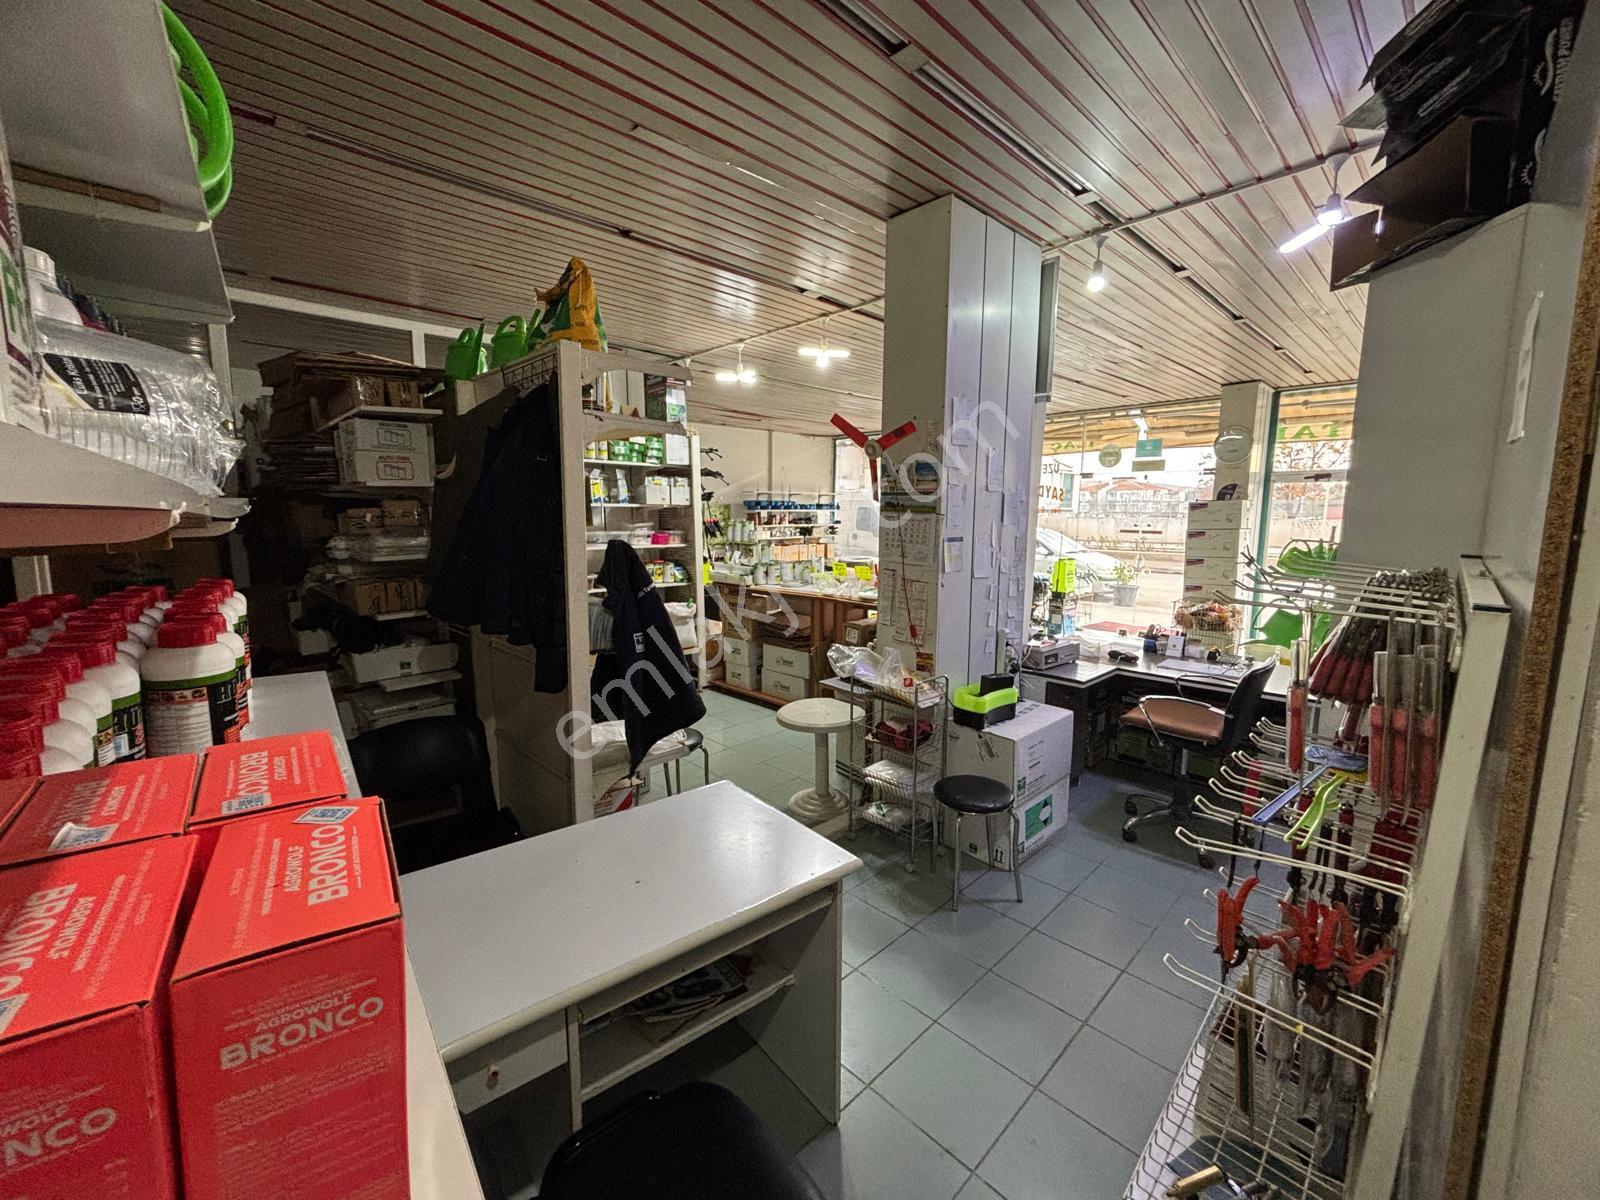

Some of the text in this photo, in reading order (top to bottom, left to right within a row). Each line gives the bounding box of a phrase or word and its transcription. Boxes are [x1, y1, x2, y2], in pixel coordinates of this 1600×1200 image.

[238, 750, 269, 796] BRONCO
[283, 845, 304, 892] AGROWOLF
[307, 824, 349, 907] BRONCO
[219, 996, 385, 1071] BRONCO
[255, 992, 353, 1034] AGROWOLF
[4, 1106, 118, 1168] NCO
